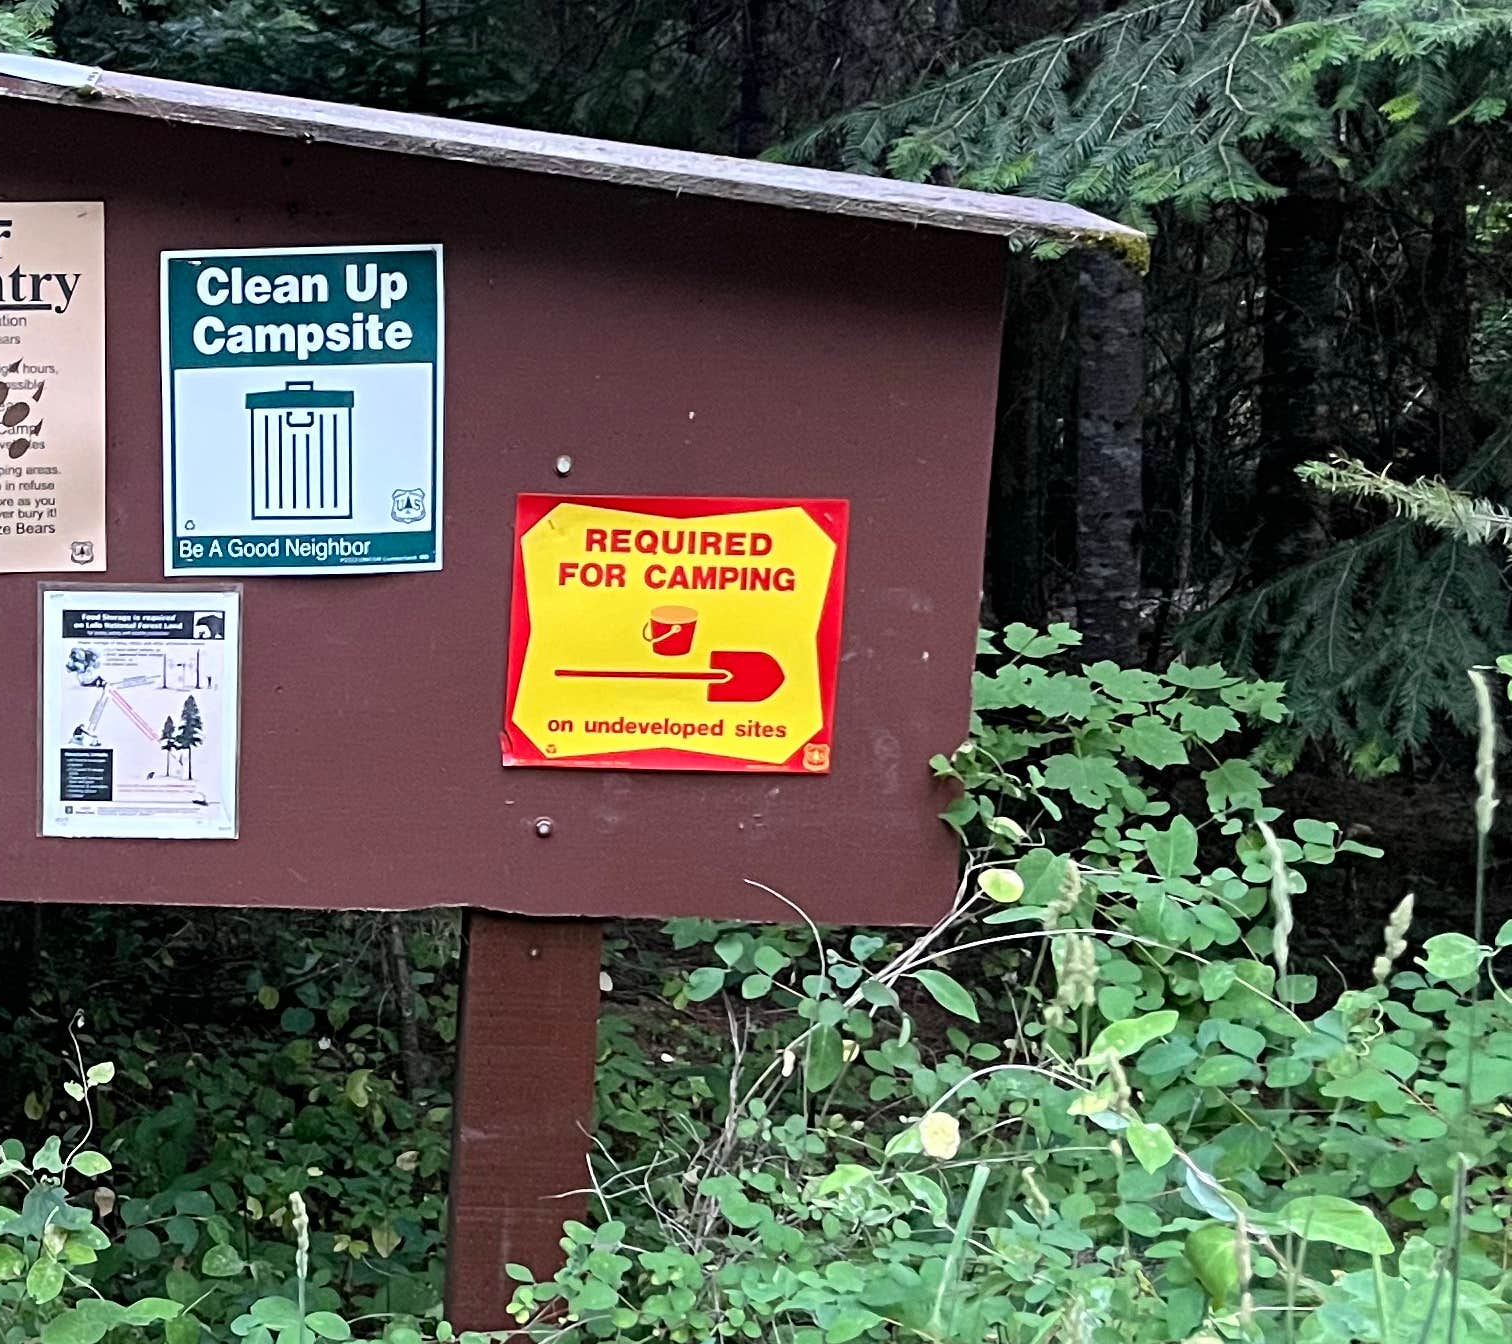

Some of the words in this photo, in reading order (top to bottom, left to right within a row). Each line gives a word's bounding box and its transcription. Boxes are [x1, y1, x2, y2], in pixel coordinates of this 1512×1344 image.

[197, 266, 328, 305] Clean
[346, 264, 407, 309] Up
[193, 313, 413, 360] Campsite
[23, 365, 58, 374] hours,
[6, 482, 15, 490] in
[19, 482, 55, 490] refuse
[35, 498, 55, 508] you
[18, 509, 43, 520] bury
[16, 523, 55, 534] Bears
[179, 540, 203, 558] Be
[209, 540, 223, 557] A
[227, 538, 280, 557] Good
[285, 538, 371, 560] Neighbor
[585, 529, 772, 556] REQUIRED
[559, 563, 626, 588] FOR
[645, 566, 795, 591] CAMPING
[548, 720, 573, 733] on
[585, 718, 724, 738] undeveloped
[735, 719, 786, 738] sites
